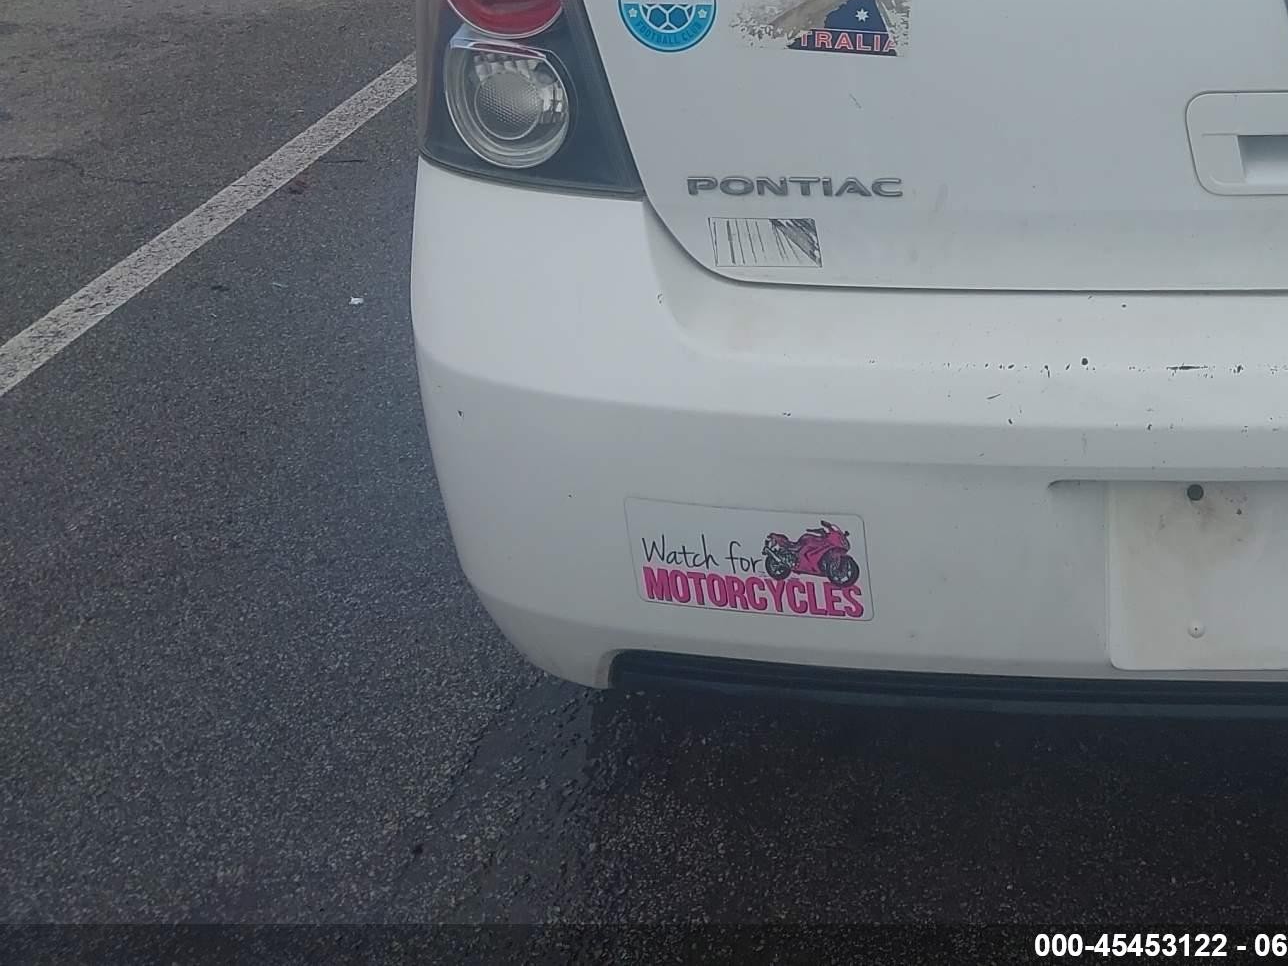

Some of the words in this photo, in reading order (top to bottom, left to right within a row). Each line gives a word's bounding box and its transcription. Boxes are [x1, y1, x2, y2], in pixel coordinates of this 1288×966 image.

[635, 20, 680, 44] FOOTBALL
[682, 21, 702, 41] CLUB
[686, 176, 904, 197] PONTIAC
[641, 534, 718, 570] Watch
[725, 541, 764, 574] for
[643, 565, 865, 619] MOTORCYCLES
